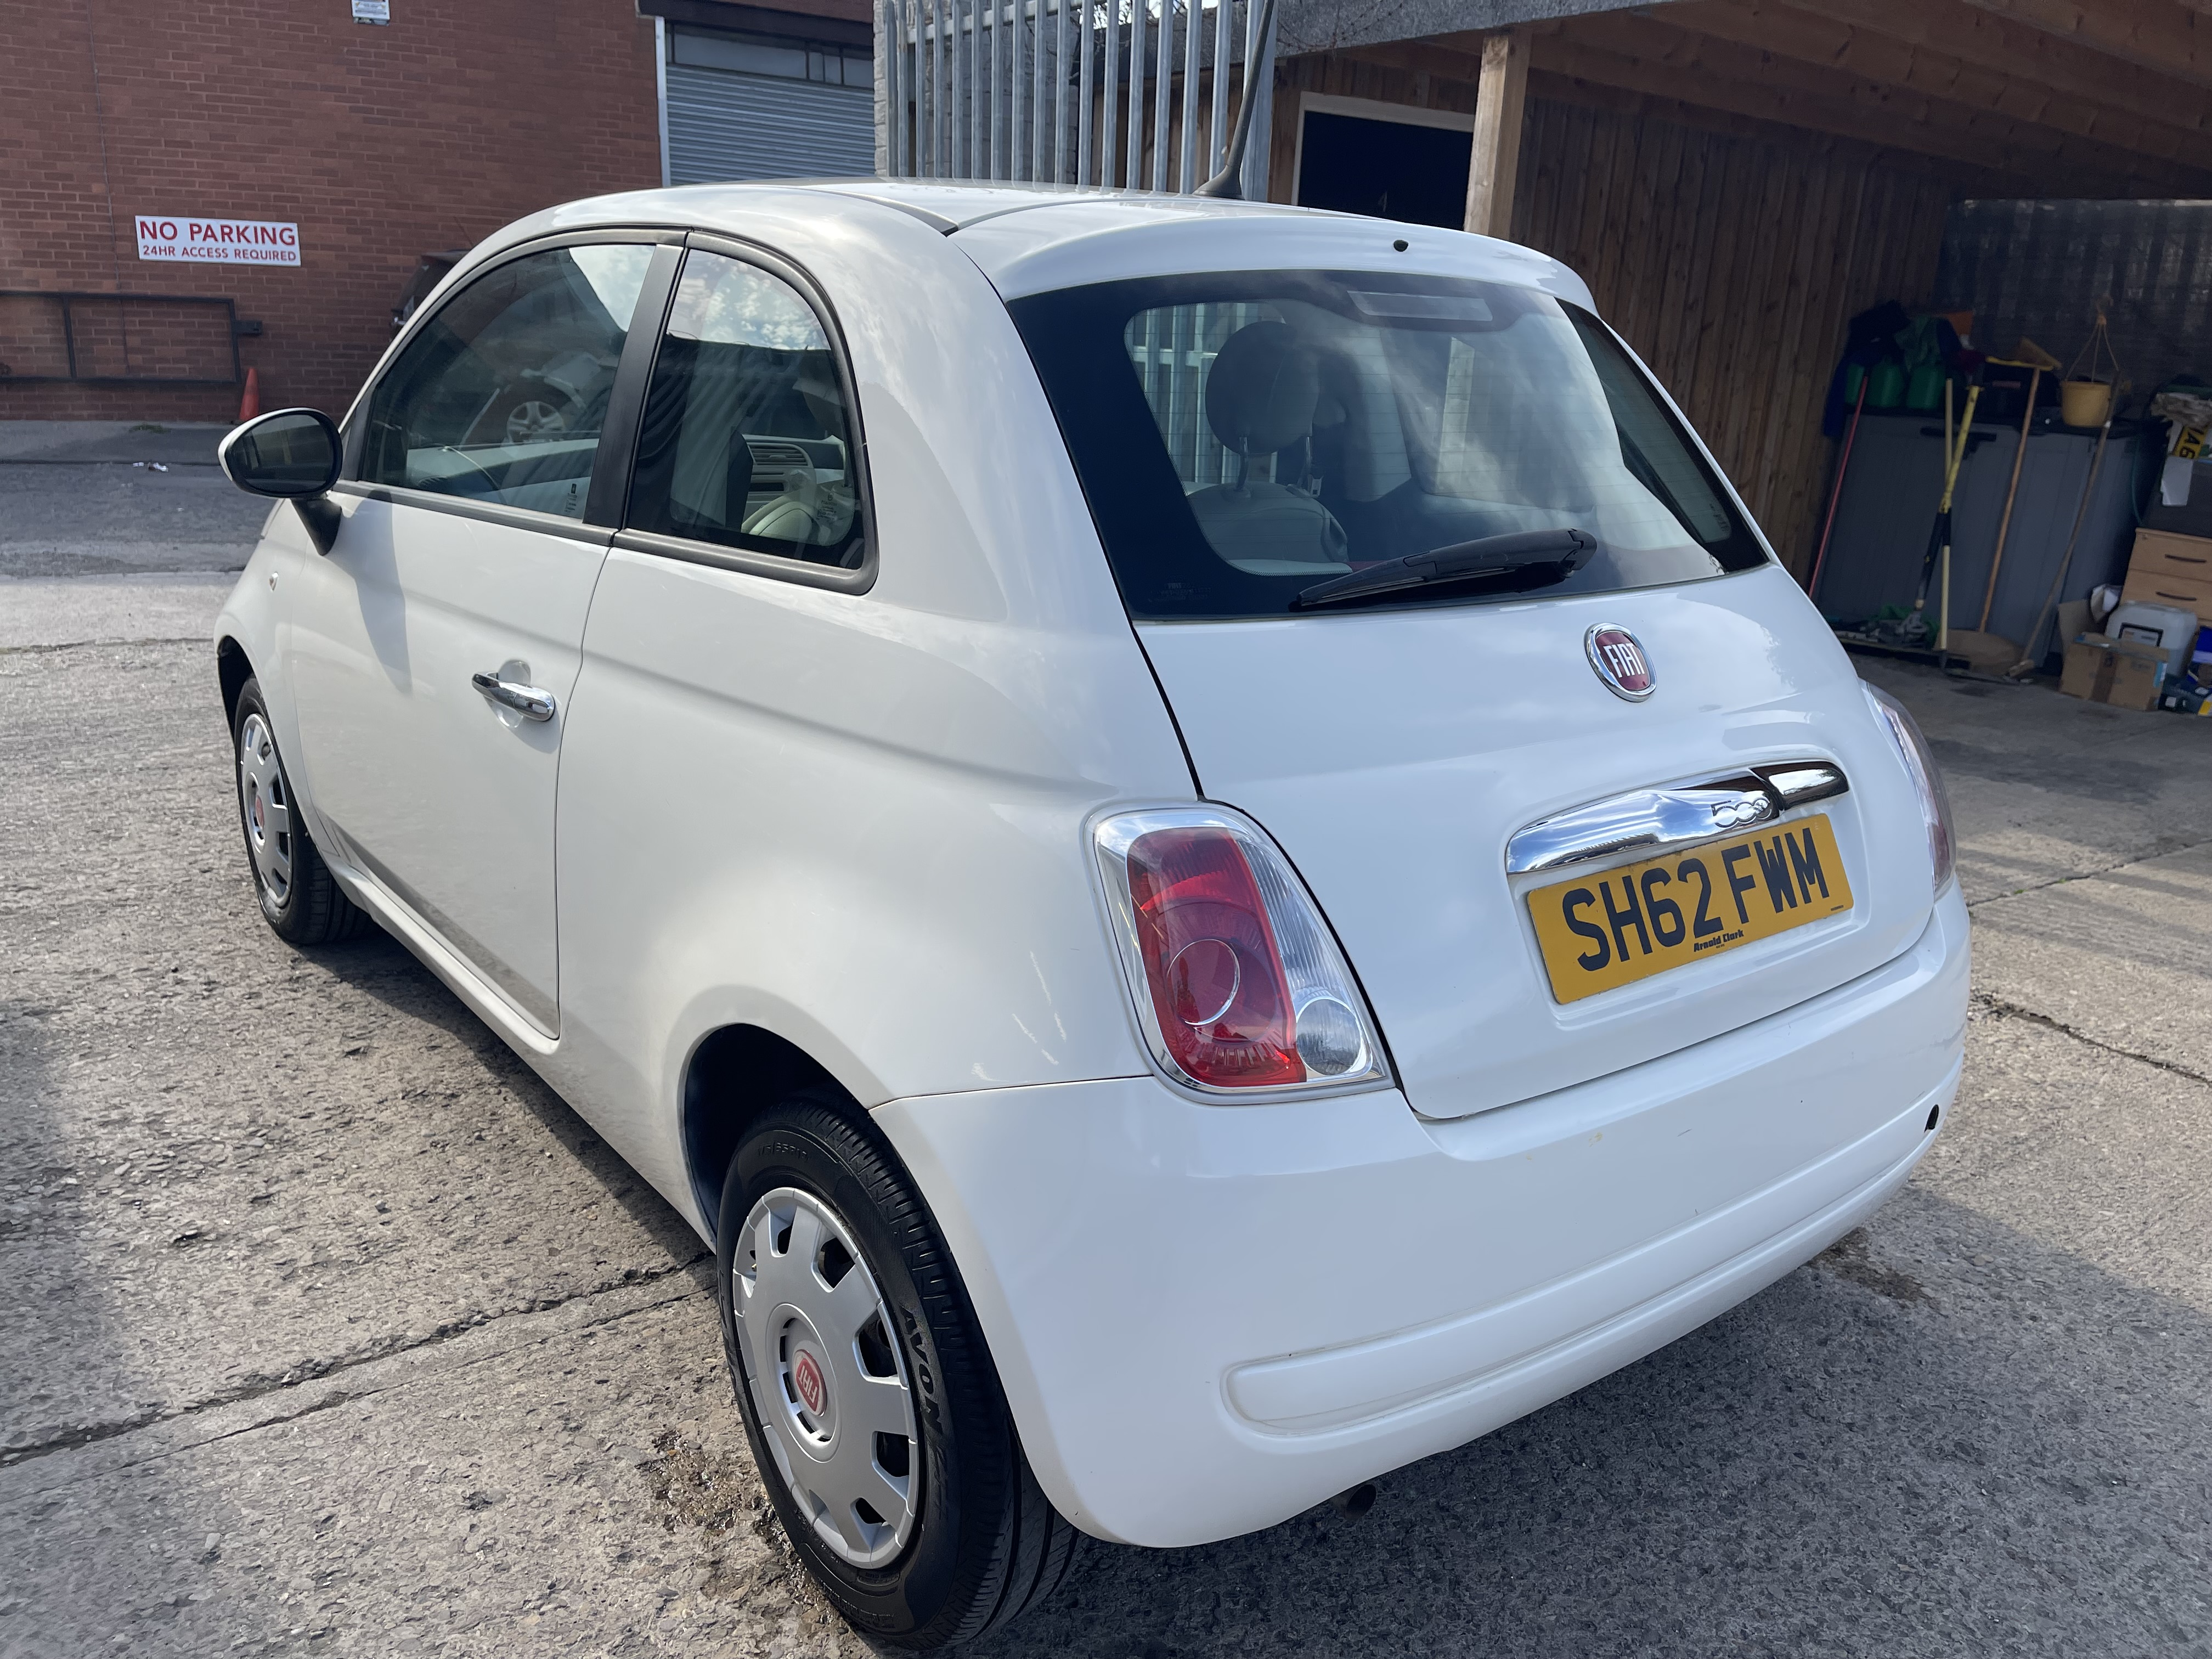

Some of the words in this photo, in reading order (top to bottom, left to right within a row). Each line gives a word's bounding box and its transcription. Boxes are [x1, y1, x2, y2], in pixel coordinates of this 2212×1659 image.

[139, 221, 178, 240] NO
[189, 223, 296, 246] PARKING
[143, 245, 176, 257] 24HR
[182, 246, 229, 259] ACCESS
[234, 249, 296, 262] REQUIRED
[1602, 642, 1645, 678] FIAT
[1711, 797, 1772, 828] 500
[1562, 857, 1724, 972] SH62
[1721, 827, 1830, 924] FWM
[1694, 935, 1722, 952] Arnold
[1722, 929, 1744, 943] Clark
[797, 1364, 818, 1404] FIAT
[899, 1305, 943, 1436] AVON
